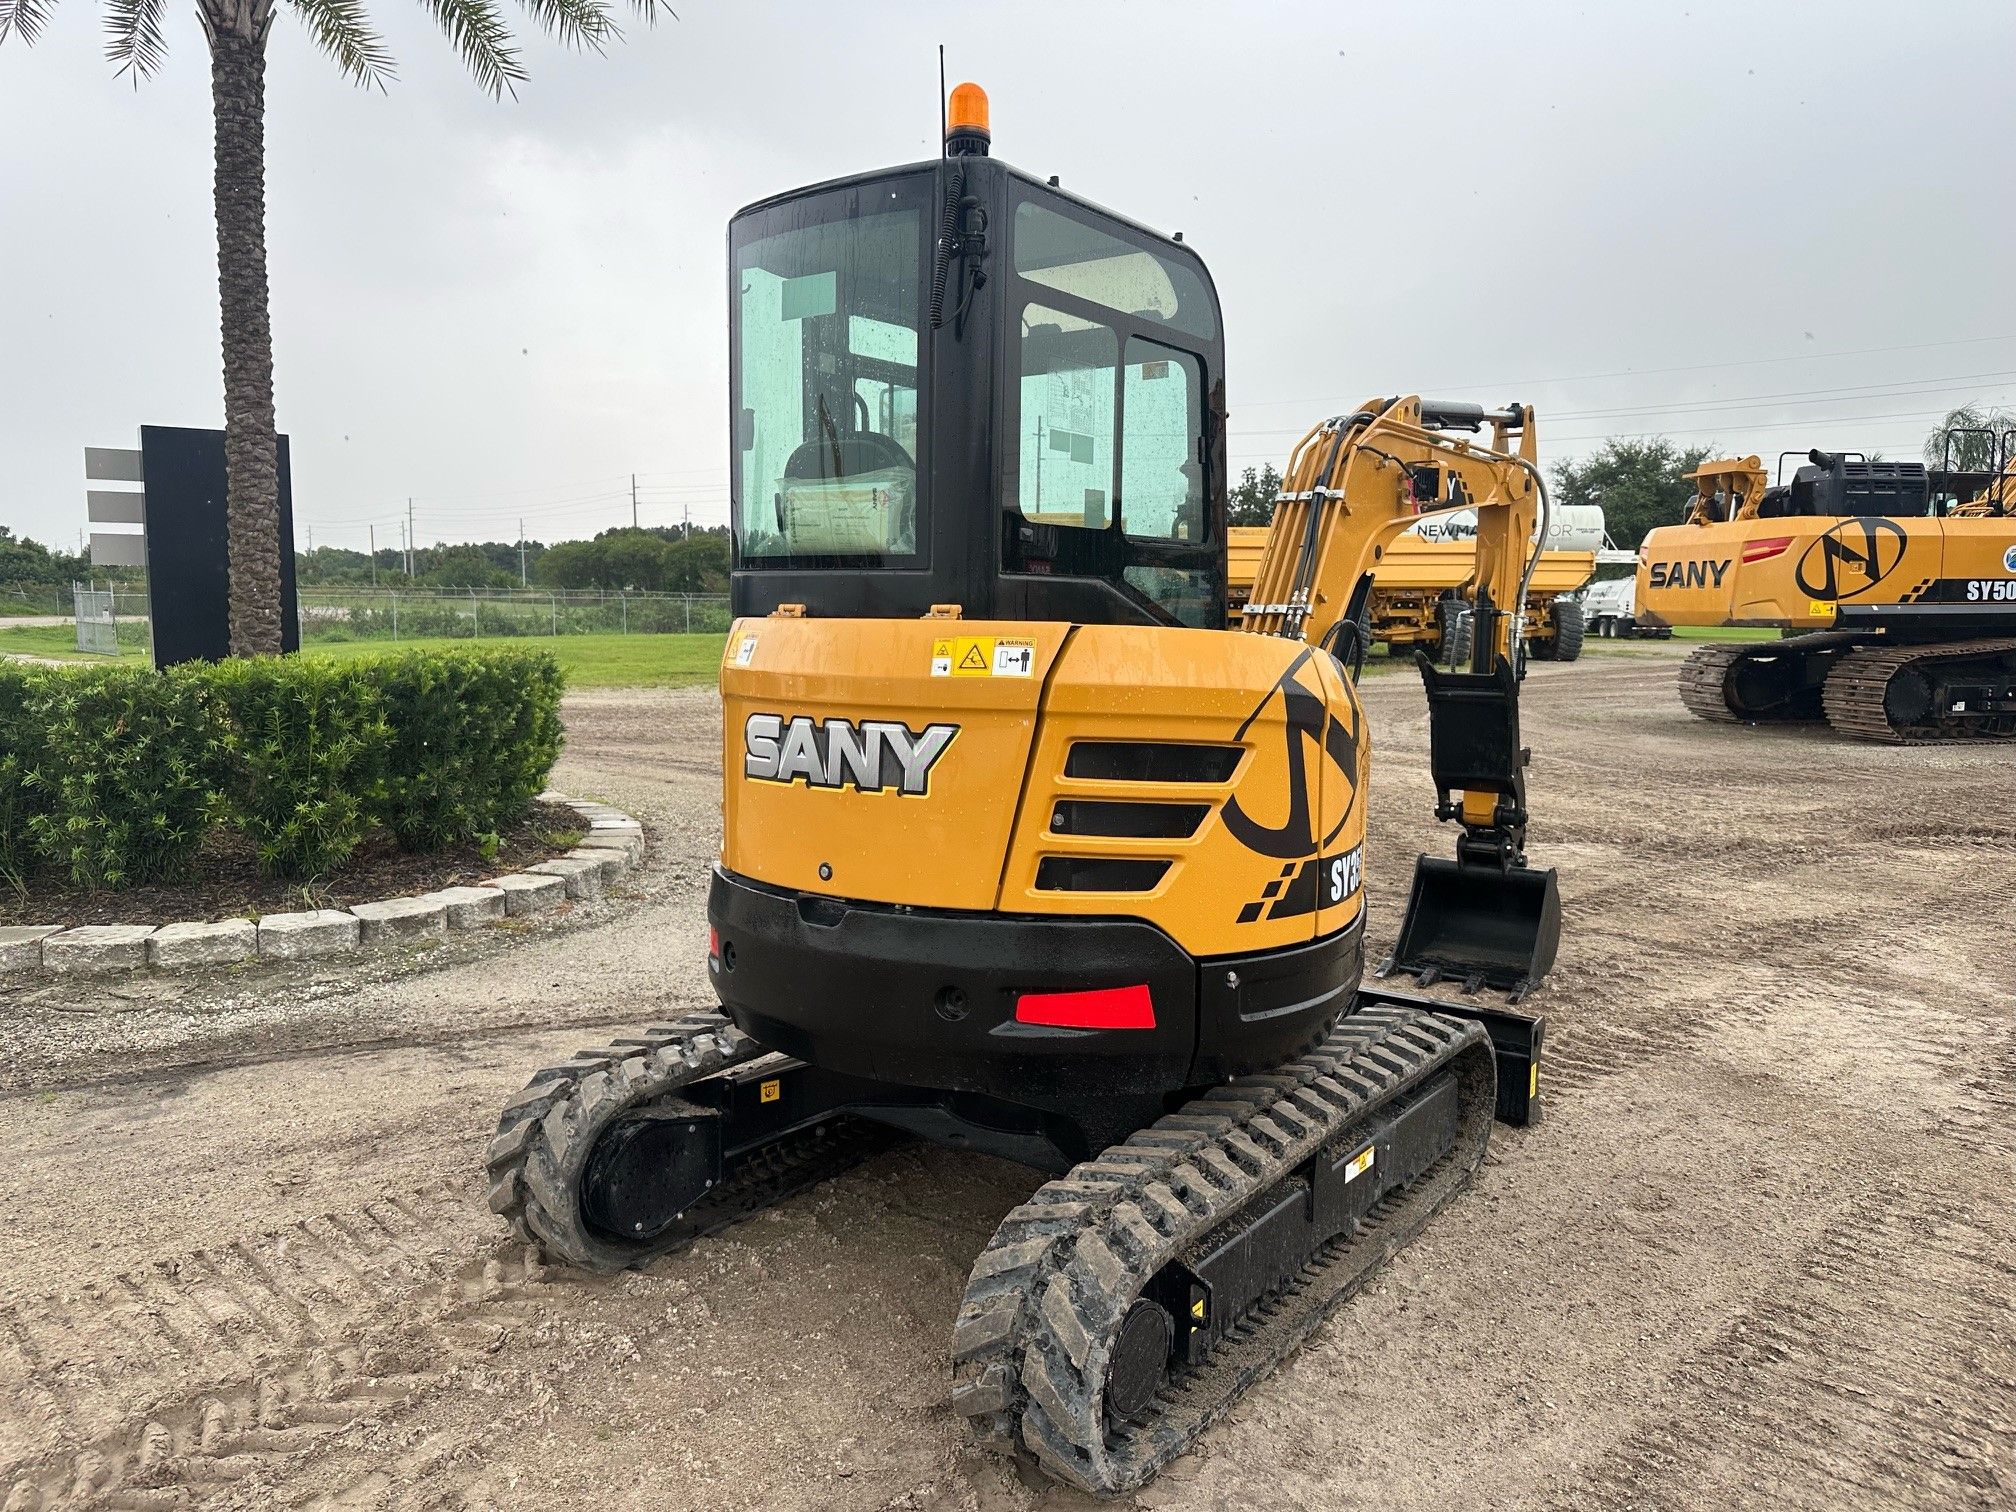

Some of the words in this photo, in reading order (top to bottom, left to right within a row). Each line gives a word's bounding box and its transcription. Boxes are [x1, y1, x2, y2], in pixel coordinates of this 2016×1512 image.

[1417, 524, 1478, 537] NEWMA
[1649, 559, 1733, 589] SANY
[1966, 580, 2016, 601] SY50
[1005, 639, 1034, 647] WARNING
[745, 713, 960, 797] SANY
